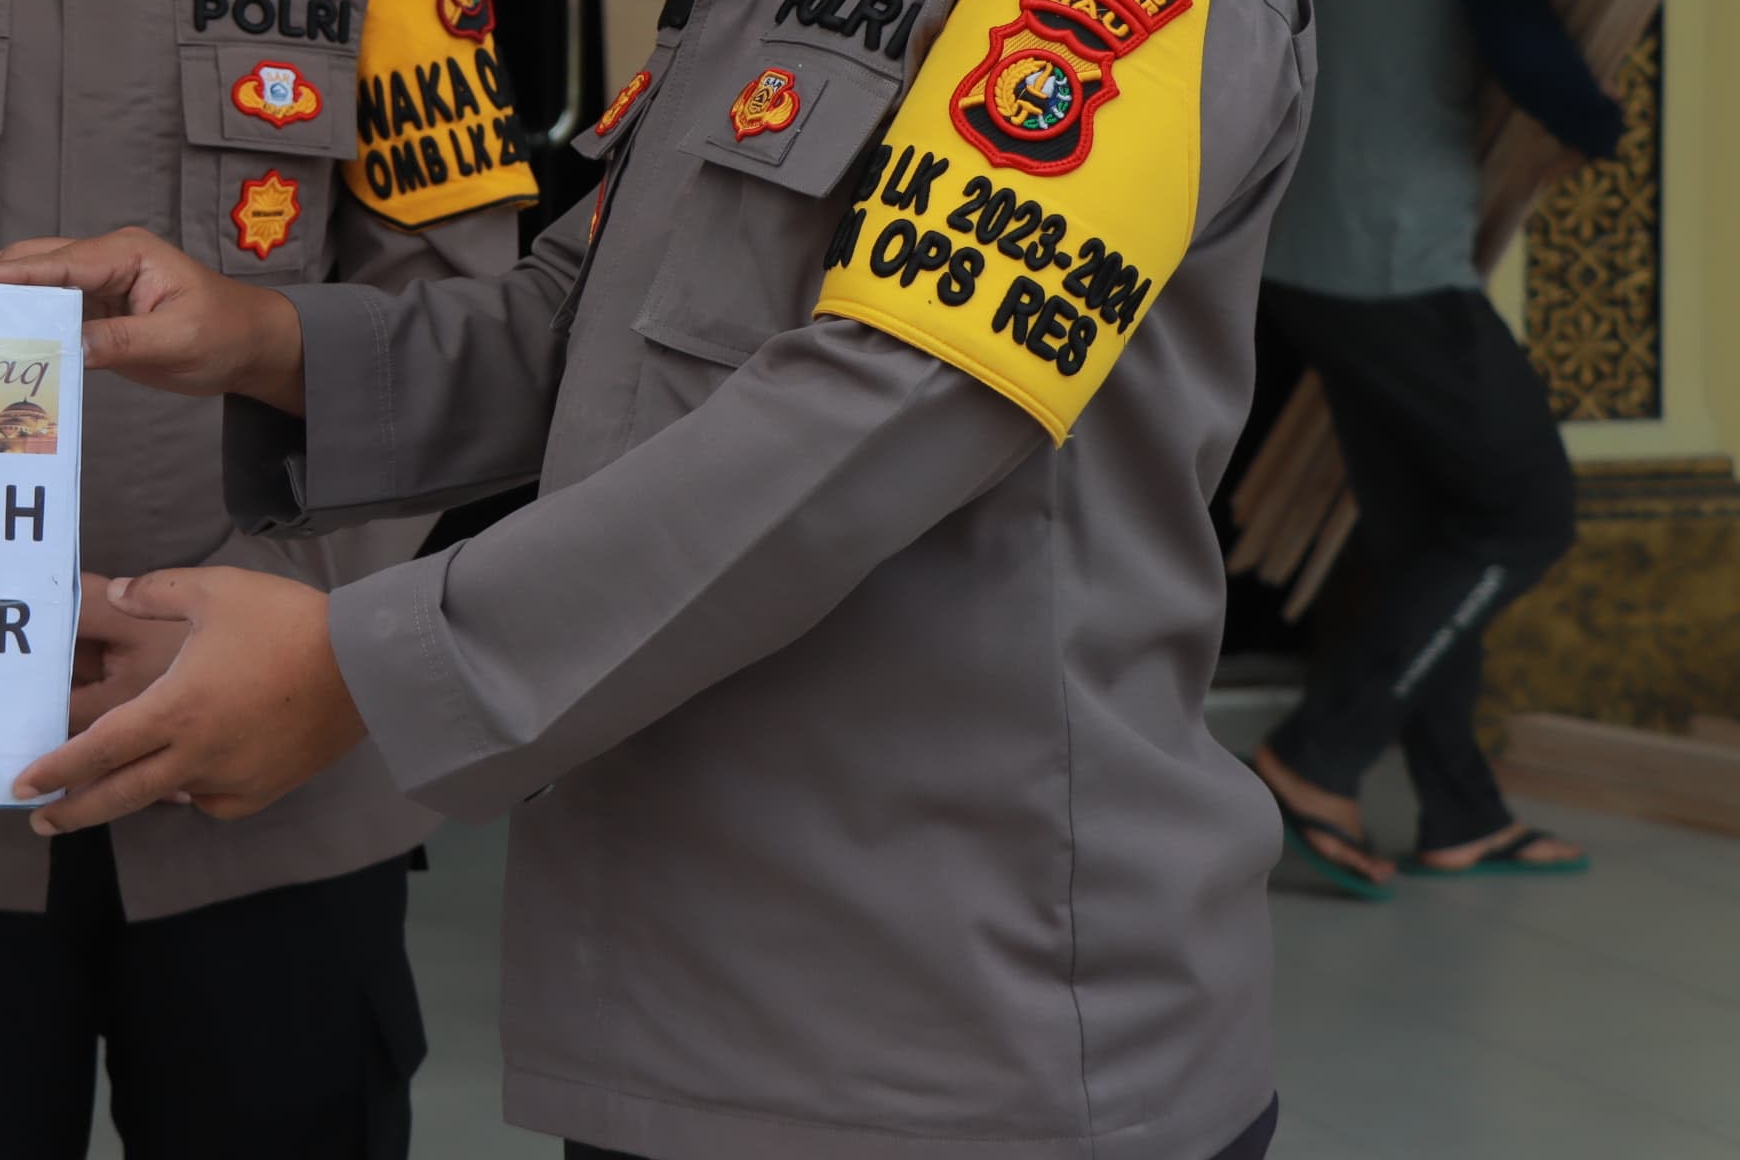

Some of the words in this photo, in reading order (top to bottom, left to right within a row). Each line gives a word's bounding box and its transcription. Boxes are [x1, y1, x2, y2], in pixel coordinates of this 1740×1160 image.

[366, 134, 448, 200] OMB
[870, 218, 986, 308] OPS
[991, 275, 1098, 377] RES
[947, 175, 1153, 335] 2023-2024
